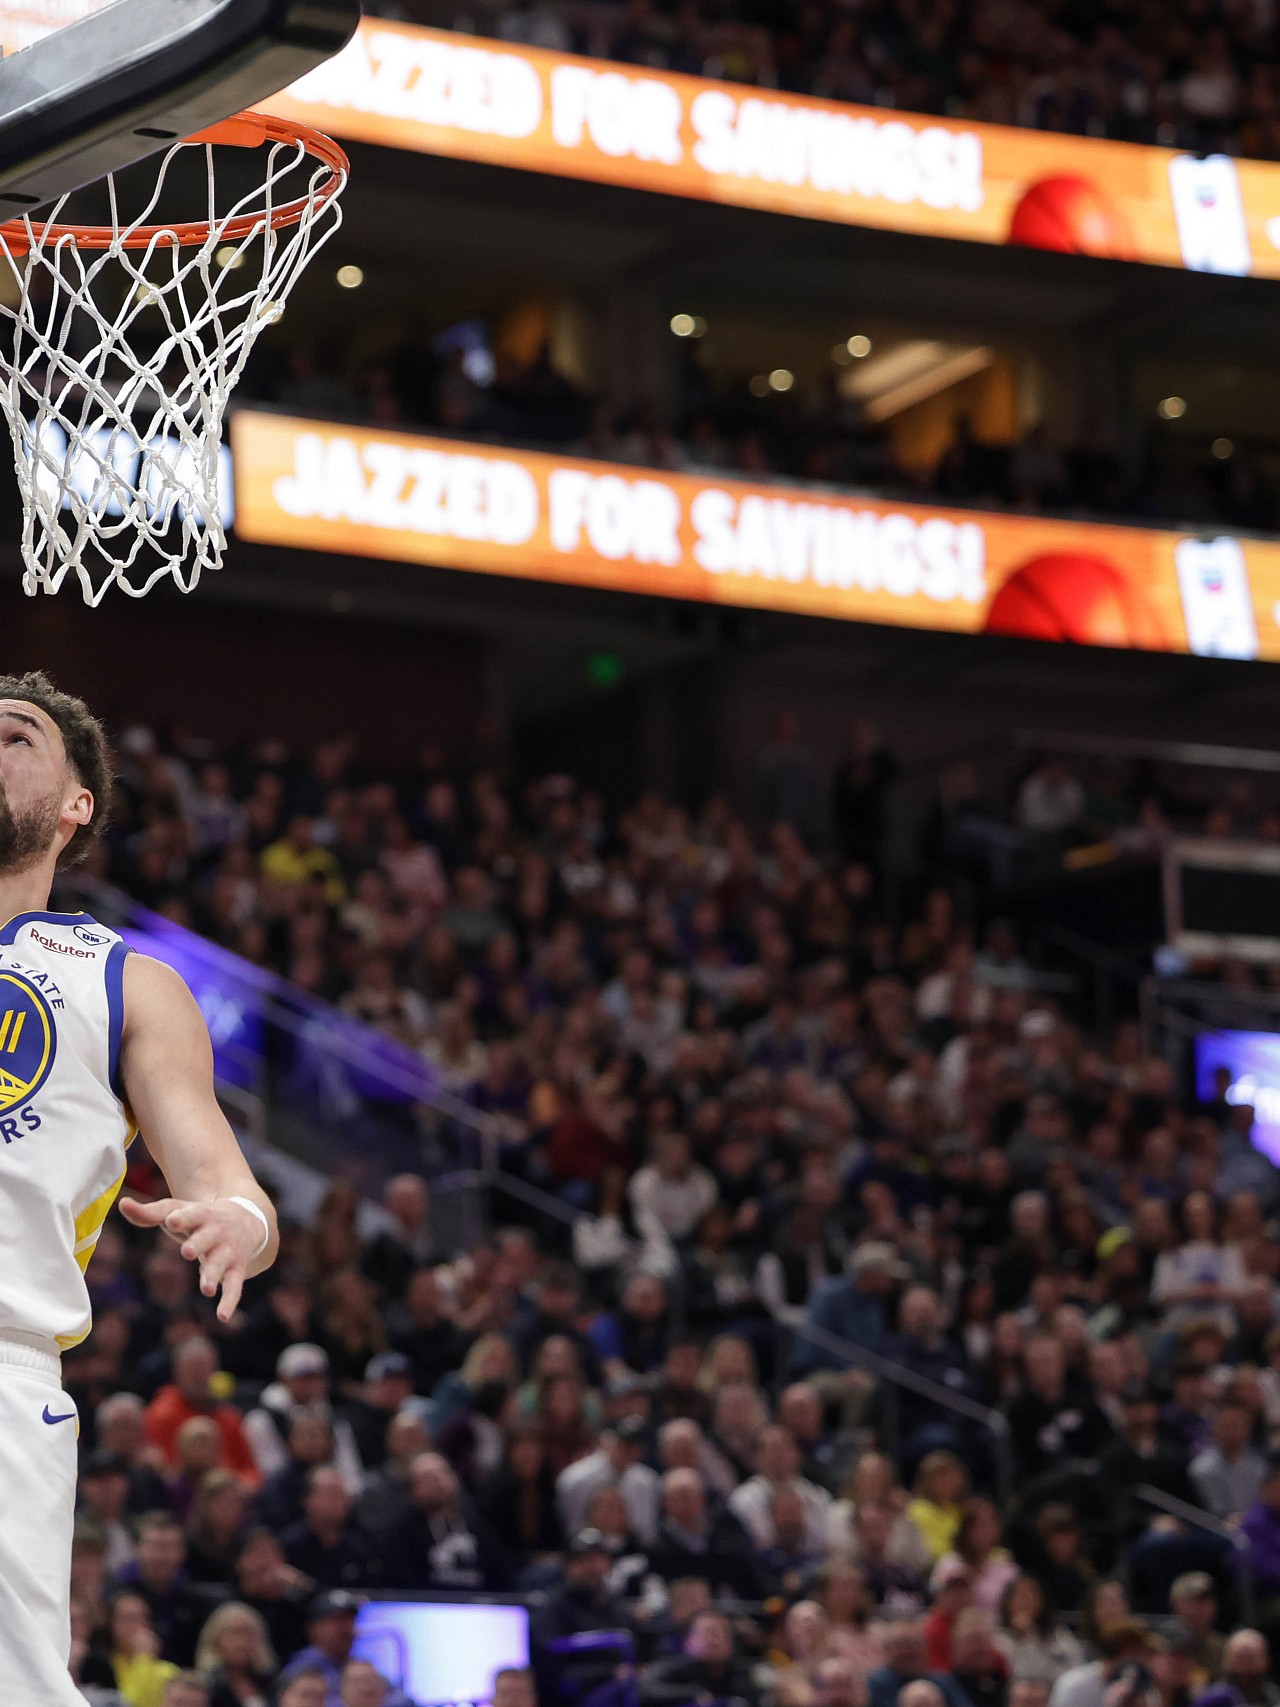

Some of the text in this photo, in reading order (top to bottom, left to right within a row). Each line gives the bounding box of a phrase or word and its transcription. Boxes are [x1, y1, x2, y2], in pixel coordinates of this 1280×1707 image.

[282, 32, 984, 212] AZZED FOR SAVINGS!
[273, 433, 539, 546] JAZZED
[548, 468, 683, 566] FOR
[690, 489, 987, 605] SAVINGS!
[30, 927, 96, 959] Rakuten
